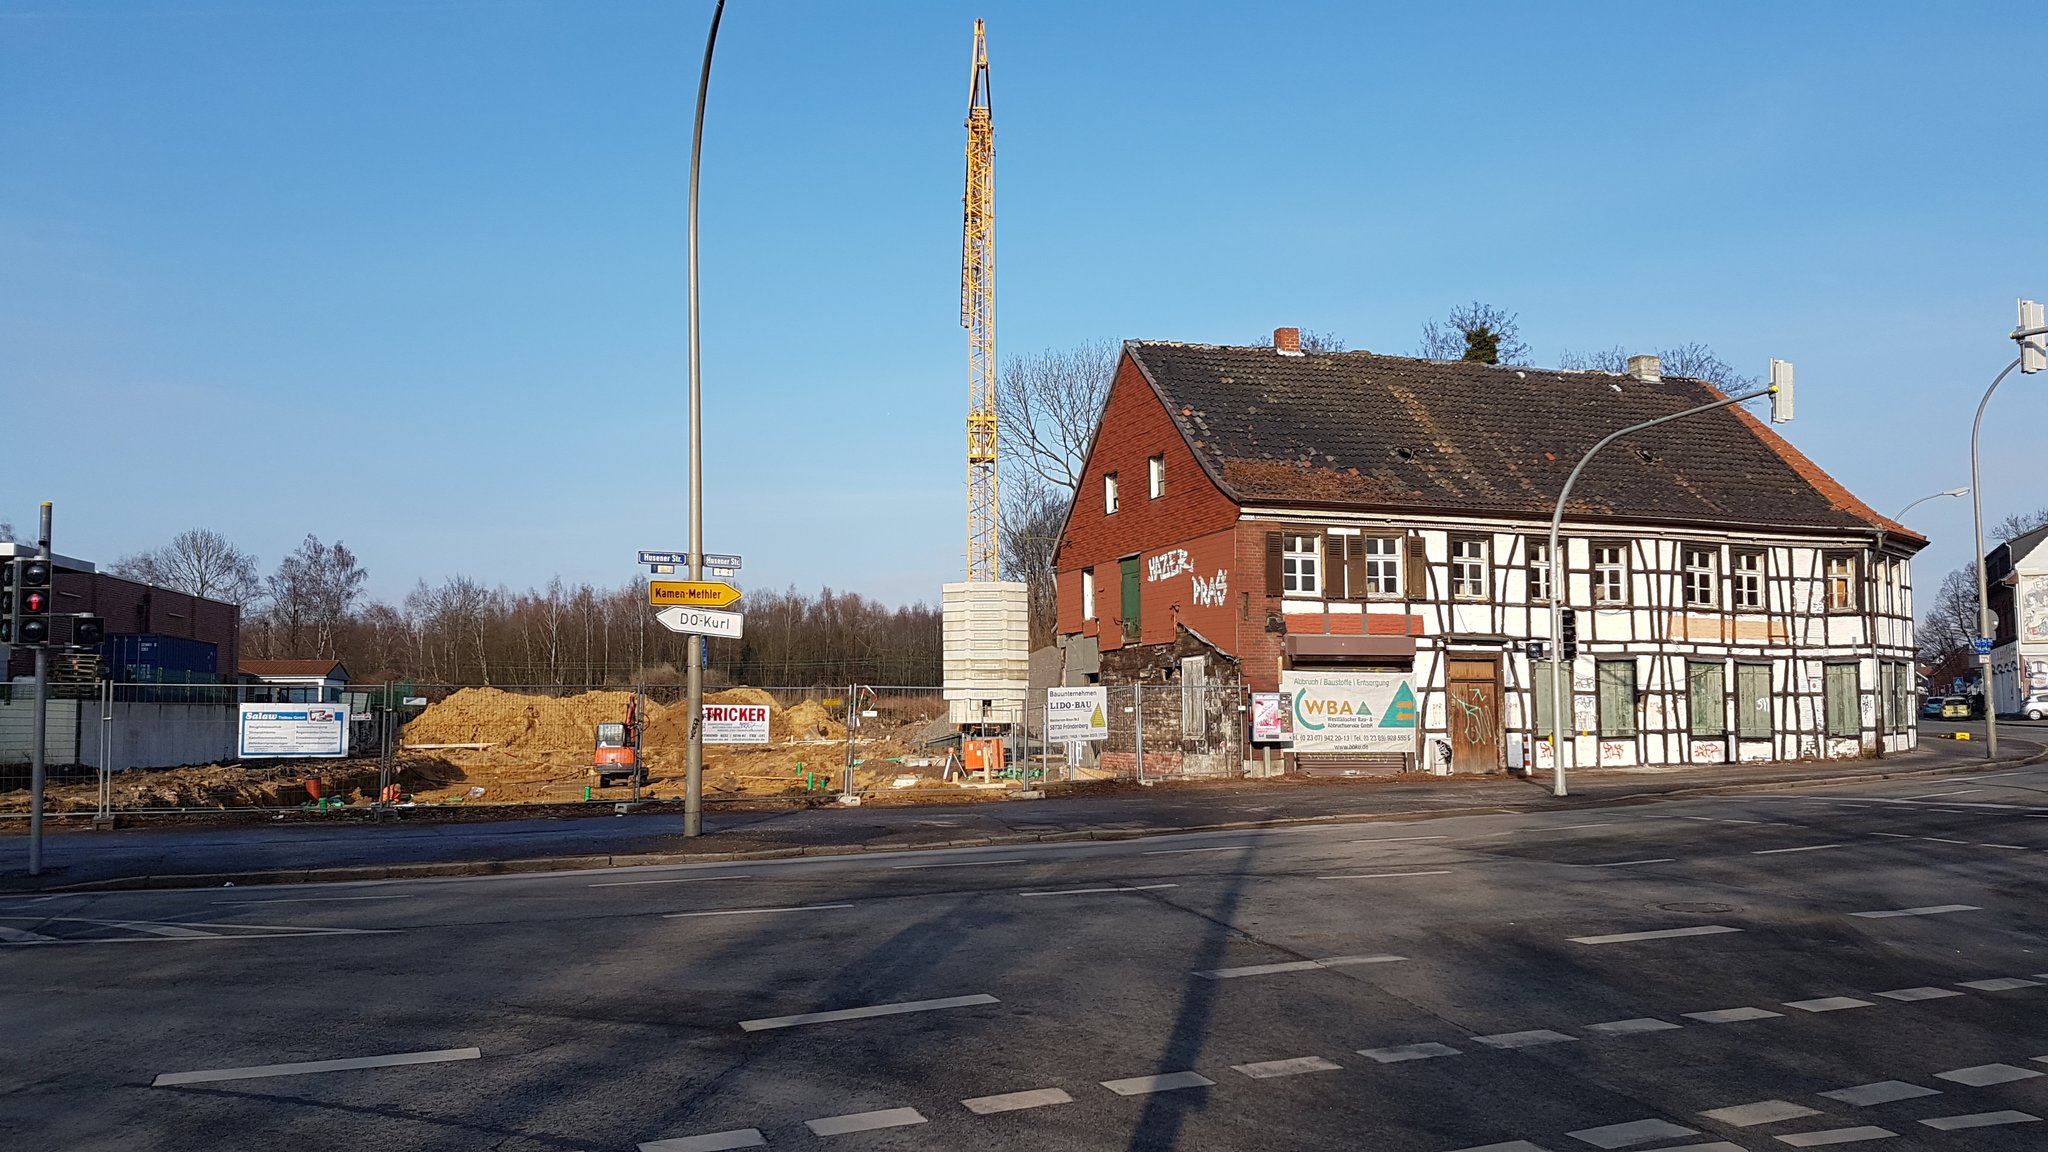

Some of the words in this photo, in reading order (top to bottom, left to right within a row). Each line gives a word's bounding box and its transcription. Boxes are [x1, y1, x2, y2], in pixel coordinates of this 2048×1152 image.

[643, 554, 671, 562] Husener
[672, 555, 683, 563] Str.
[706, 556, 730, 565] Husener
[731, 558, 740, 566] Str.
[655, 587, 722, 600] Kamen-Methler
[680, 612, 730, 630] DO-Kurl
[1294, 678, 1319, 686] Abbruch
[1323, 678, 1353, 687] Baustoffe
[1356, 679, 1390, 688] Entsorgung
[1305, 700, 1353, 715] WBA
[245, 712, 278, 720] Salaw
[702, 707, 766, 722] TRICKER
